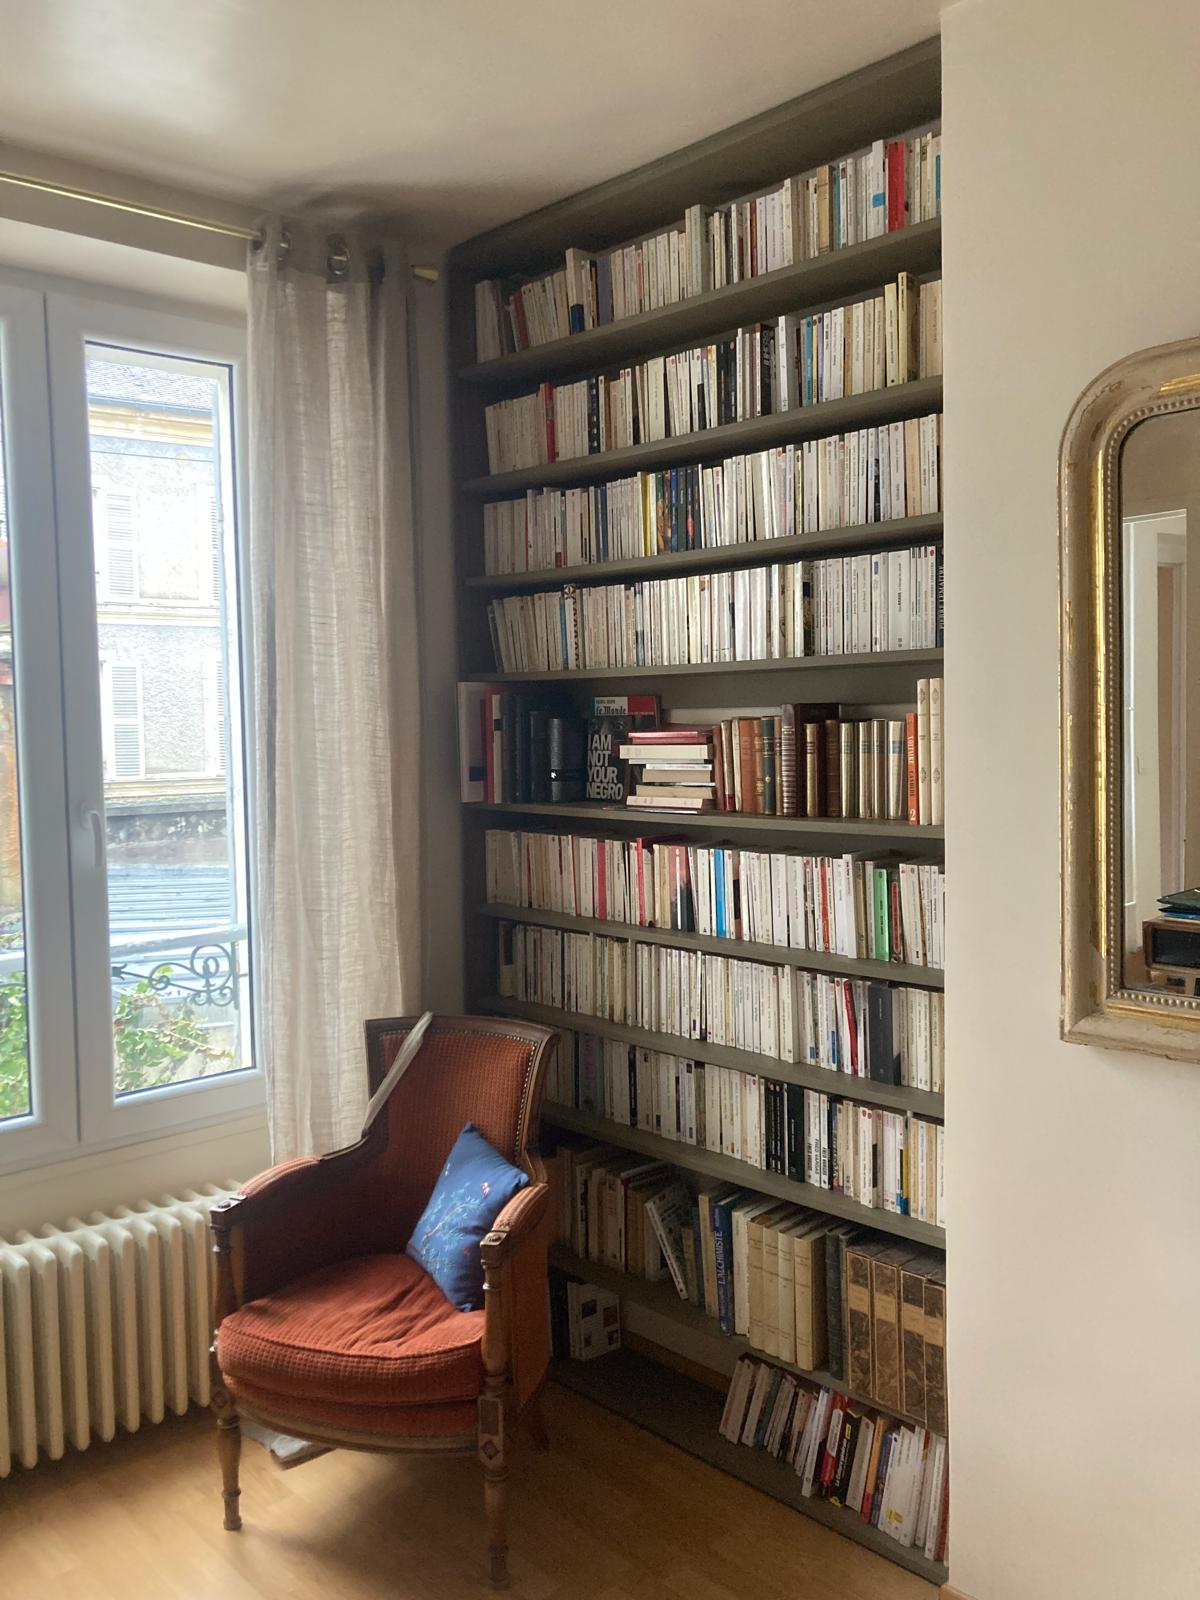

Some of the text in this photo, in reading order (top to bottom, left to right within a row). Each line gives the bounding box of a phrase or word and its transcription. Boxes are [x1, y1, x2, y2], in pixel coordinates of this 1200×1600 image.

[603, 705, 627, 715] Monde
[592, 734, 612, 750] AM
[587, 750, 611, 767] NOT
[588, 766, 618, 783] YOUR
[586, 782, 624, 800] NEGRO
